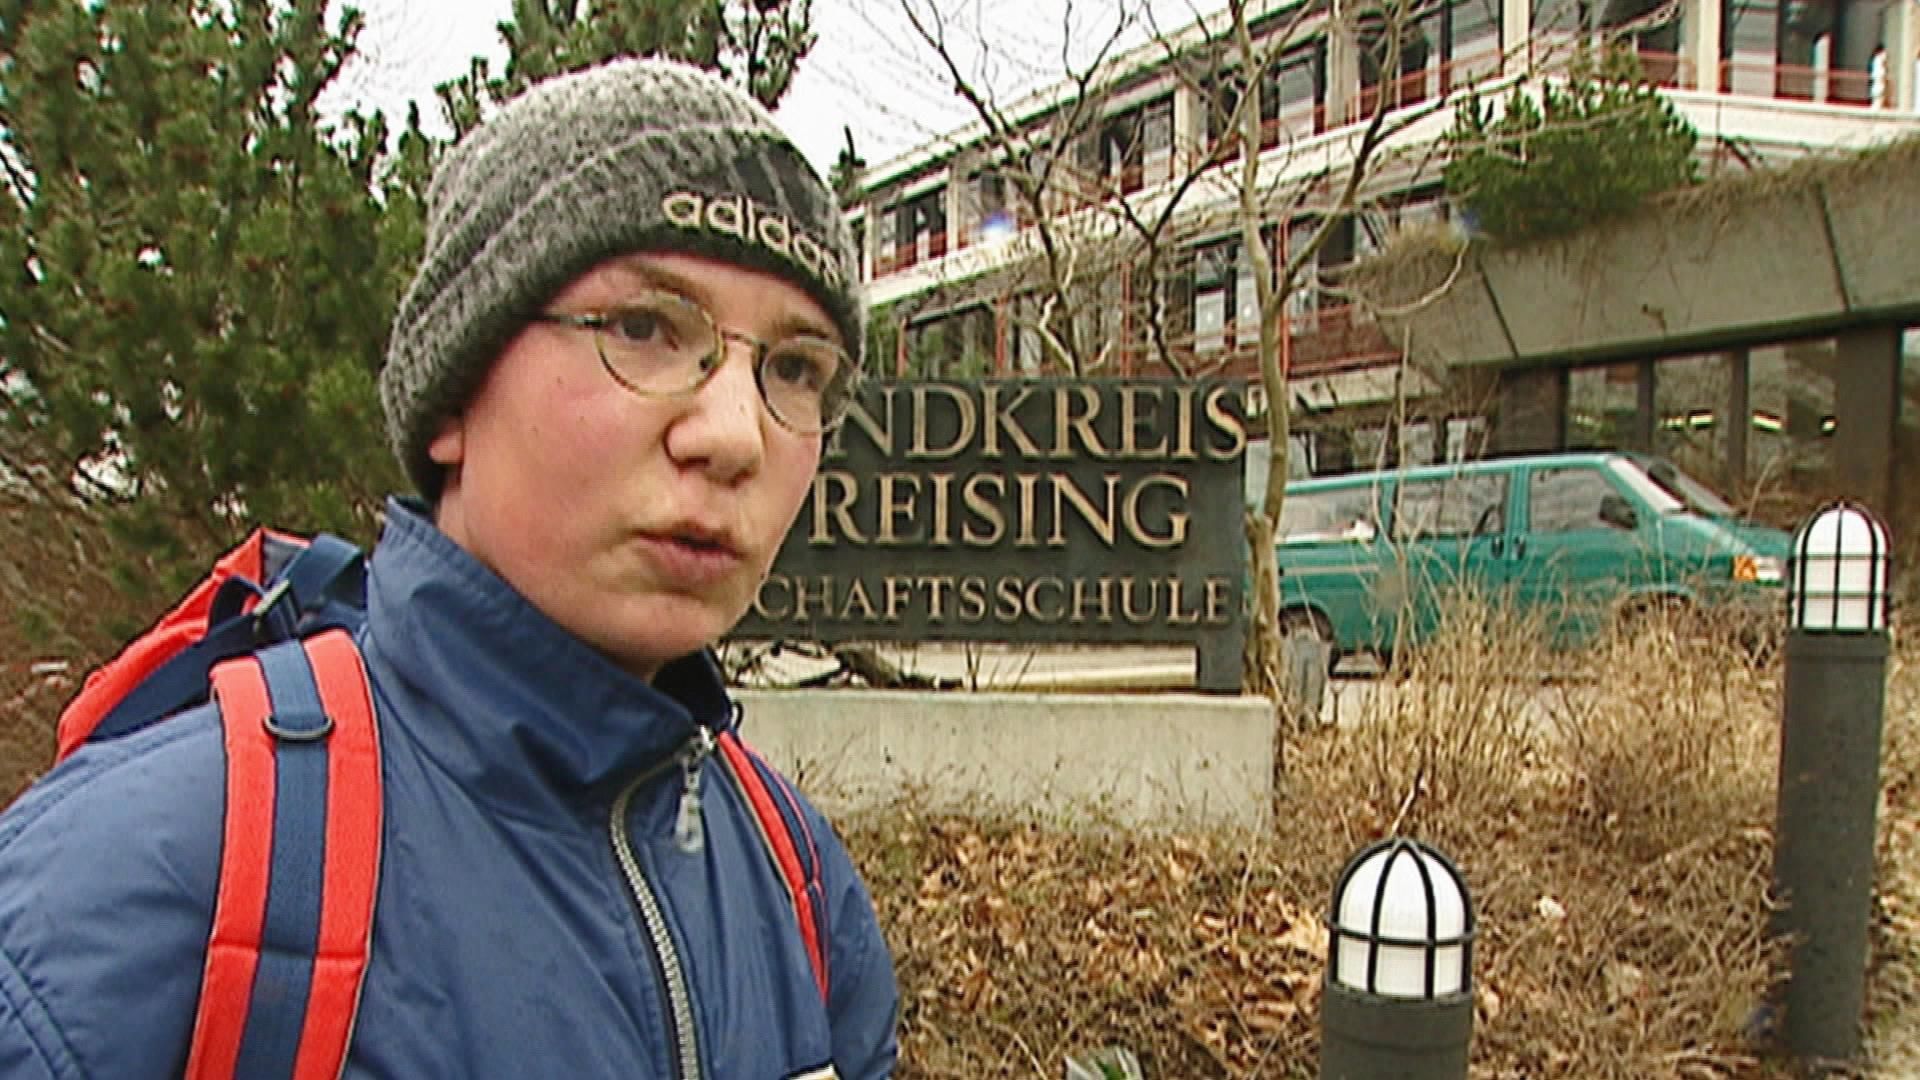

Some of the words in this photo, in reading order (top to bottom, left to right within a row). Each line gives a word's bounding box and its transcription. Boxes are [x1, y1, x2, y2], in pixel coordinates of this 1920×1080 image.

[824, 384, 1247, 460] NDKREIS
[807, 472, 1191, 548] REISING
[754, 574, 1233, 625] CHAFTSSCHULE
